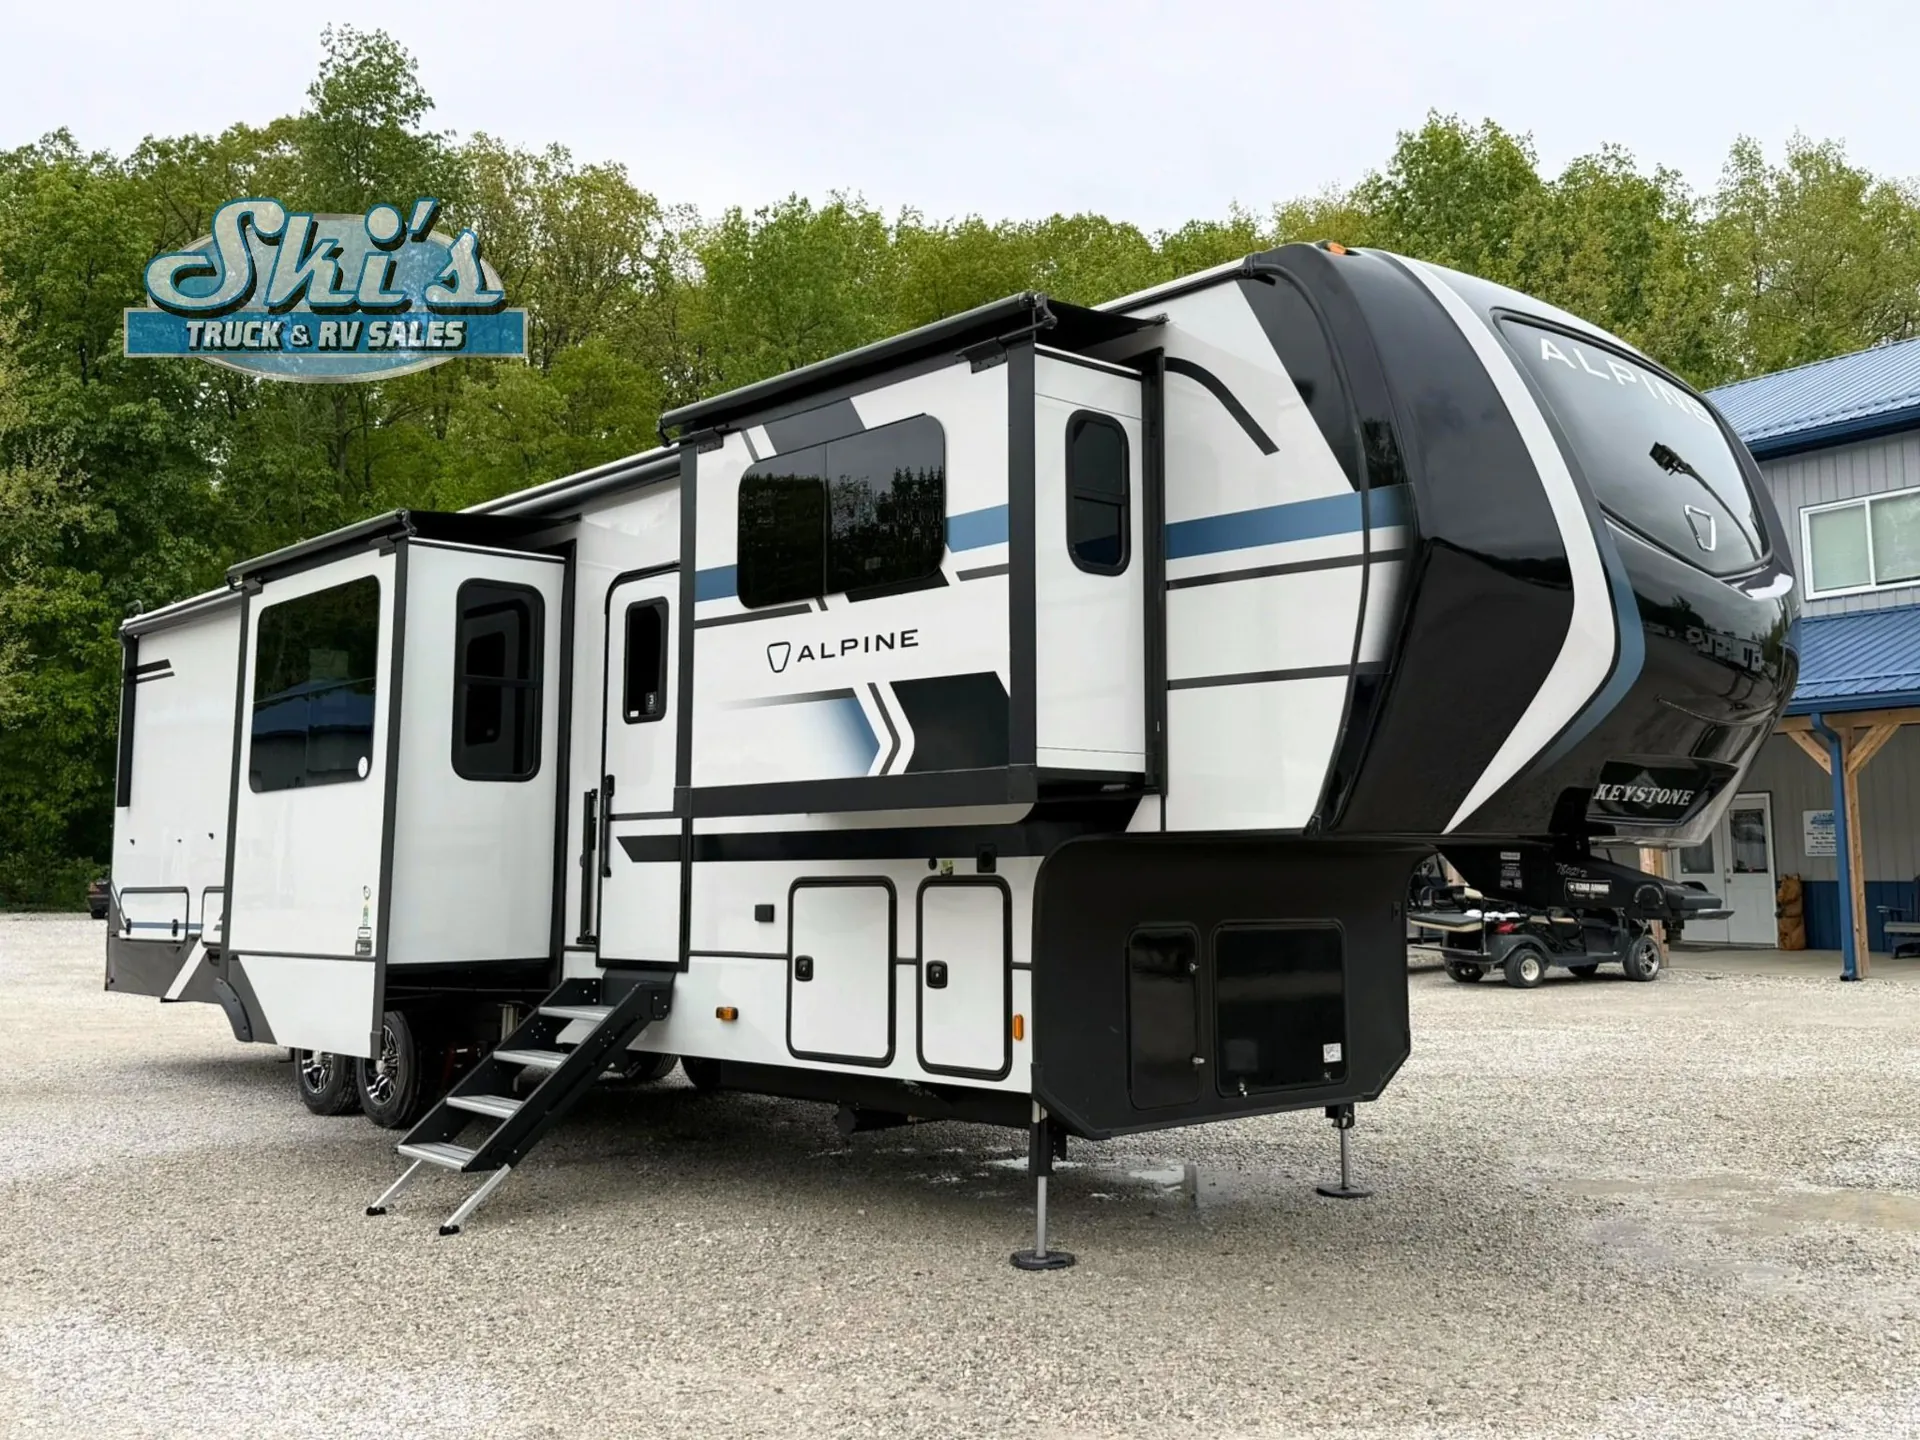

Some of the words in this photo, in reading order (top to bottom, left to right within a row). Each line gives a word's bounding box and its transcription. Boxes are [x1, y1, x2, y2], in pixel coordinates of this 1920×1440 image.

[1540, 338, 1716, 428] ALPINE
[797, 628, 919, 663] ALPINE
[1593, 783, 1695, 806] KEYSTONE
